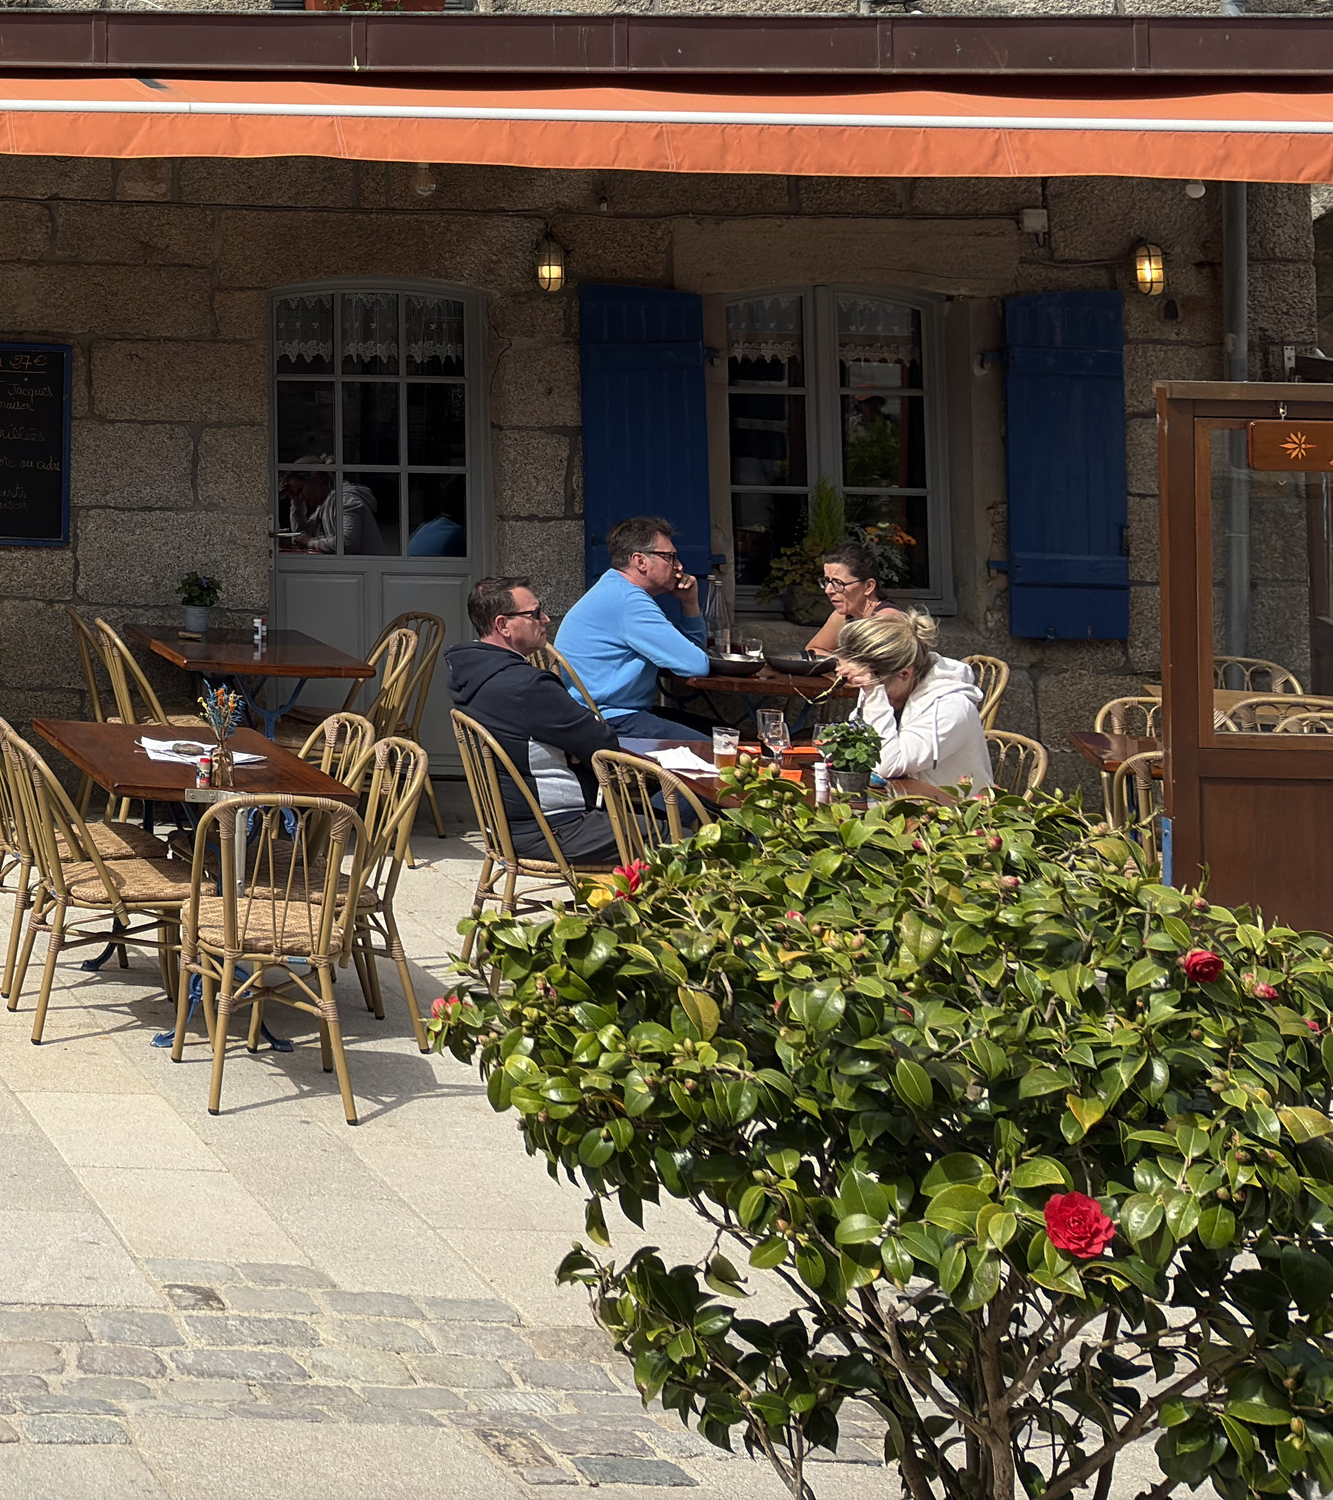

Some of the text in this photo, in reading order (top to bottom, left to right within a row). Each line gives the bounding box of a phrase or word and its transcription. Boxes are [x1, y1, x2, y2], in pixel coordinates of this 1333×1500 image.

[7, 382, 54, 404] Jacques
[19, 459, 34, 468] au
[36, 455, 61, 471] cidre
